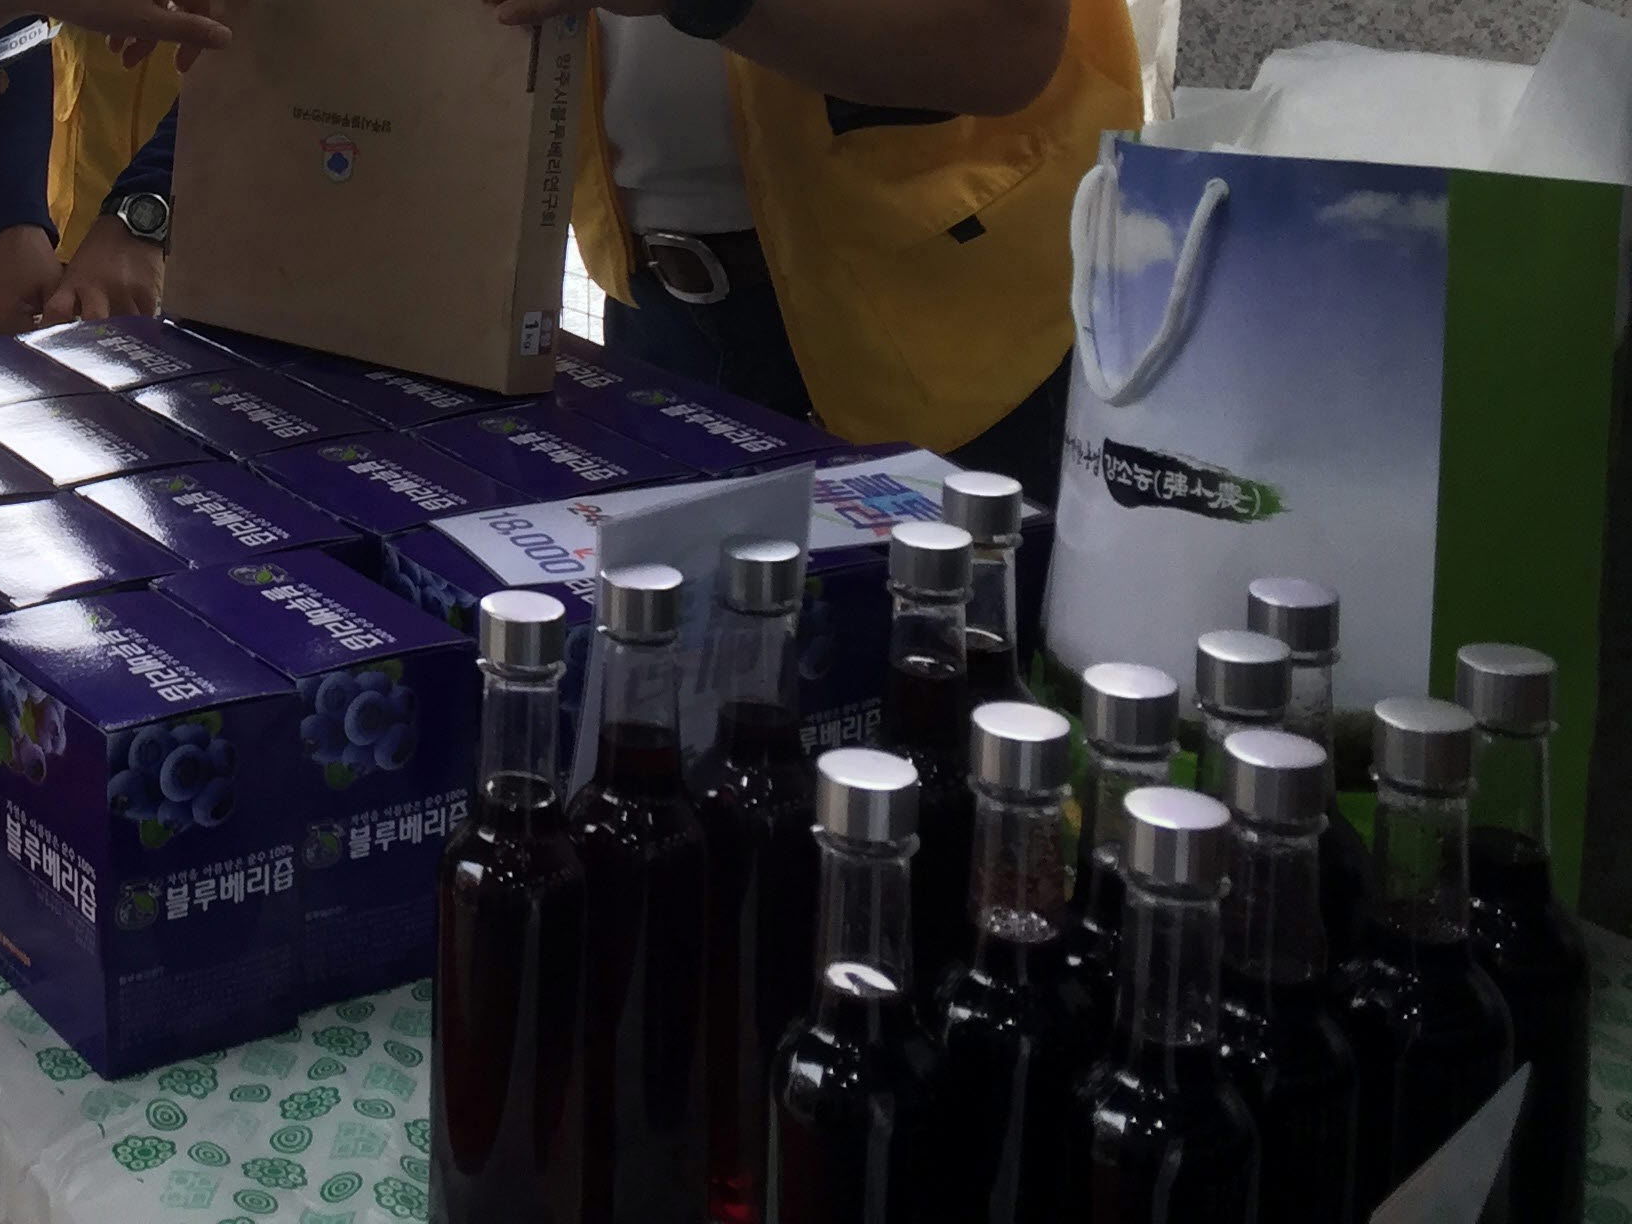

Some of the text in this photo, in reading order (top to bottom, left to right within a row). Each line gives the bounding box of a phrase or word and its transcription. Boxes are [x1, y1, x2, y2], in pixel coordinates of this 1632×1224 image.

[507, 431, 619, 481] 블루베리즙
[659, 404, 778, 452] 블루베리즙
[347, 460, 459, 511] 블루베리즙
[172, 491, 279, 547] 블루베리즙
[479, 511, 586, 574] 18,000
[261, 584, 384, 651] 블루베리즙
[96, 629, 204, 703] 블루베리즙
[6, 812, 97, 924] 블루베리즙
[165, 856, 295, 921] 블루베리즙
